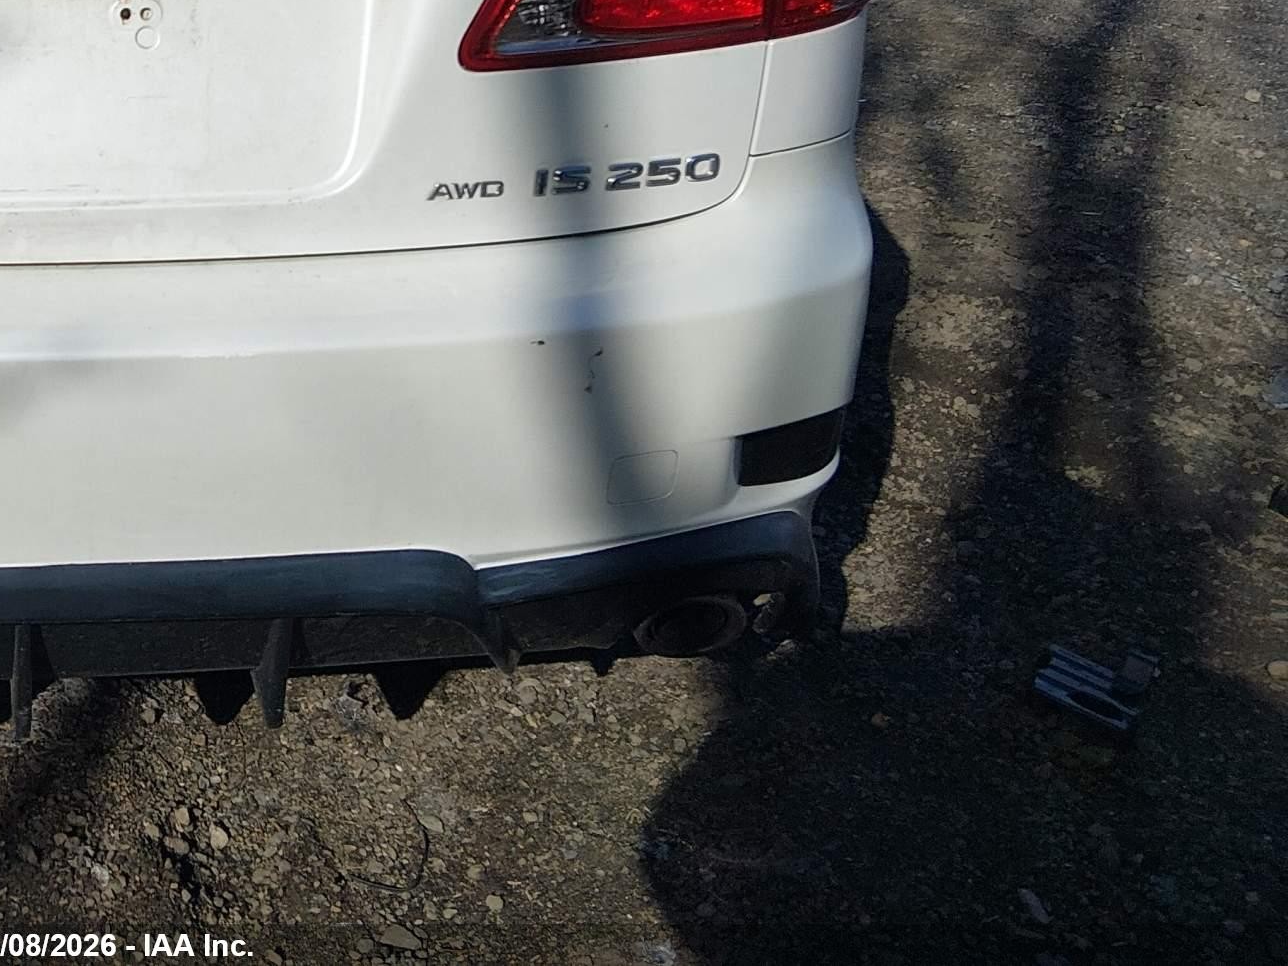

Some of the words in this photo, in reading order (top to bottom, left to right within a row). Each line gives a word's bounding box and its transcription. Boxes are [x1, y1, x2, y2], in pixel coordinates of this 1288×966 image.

[426, 179, 505, 201] AWD
[534, 165, 592, 197] IS
[606, 153, 720, 191] 250
